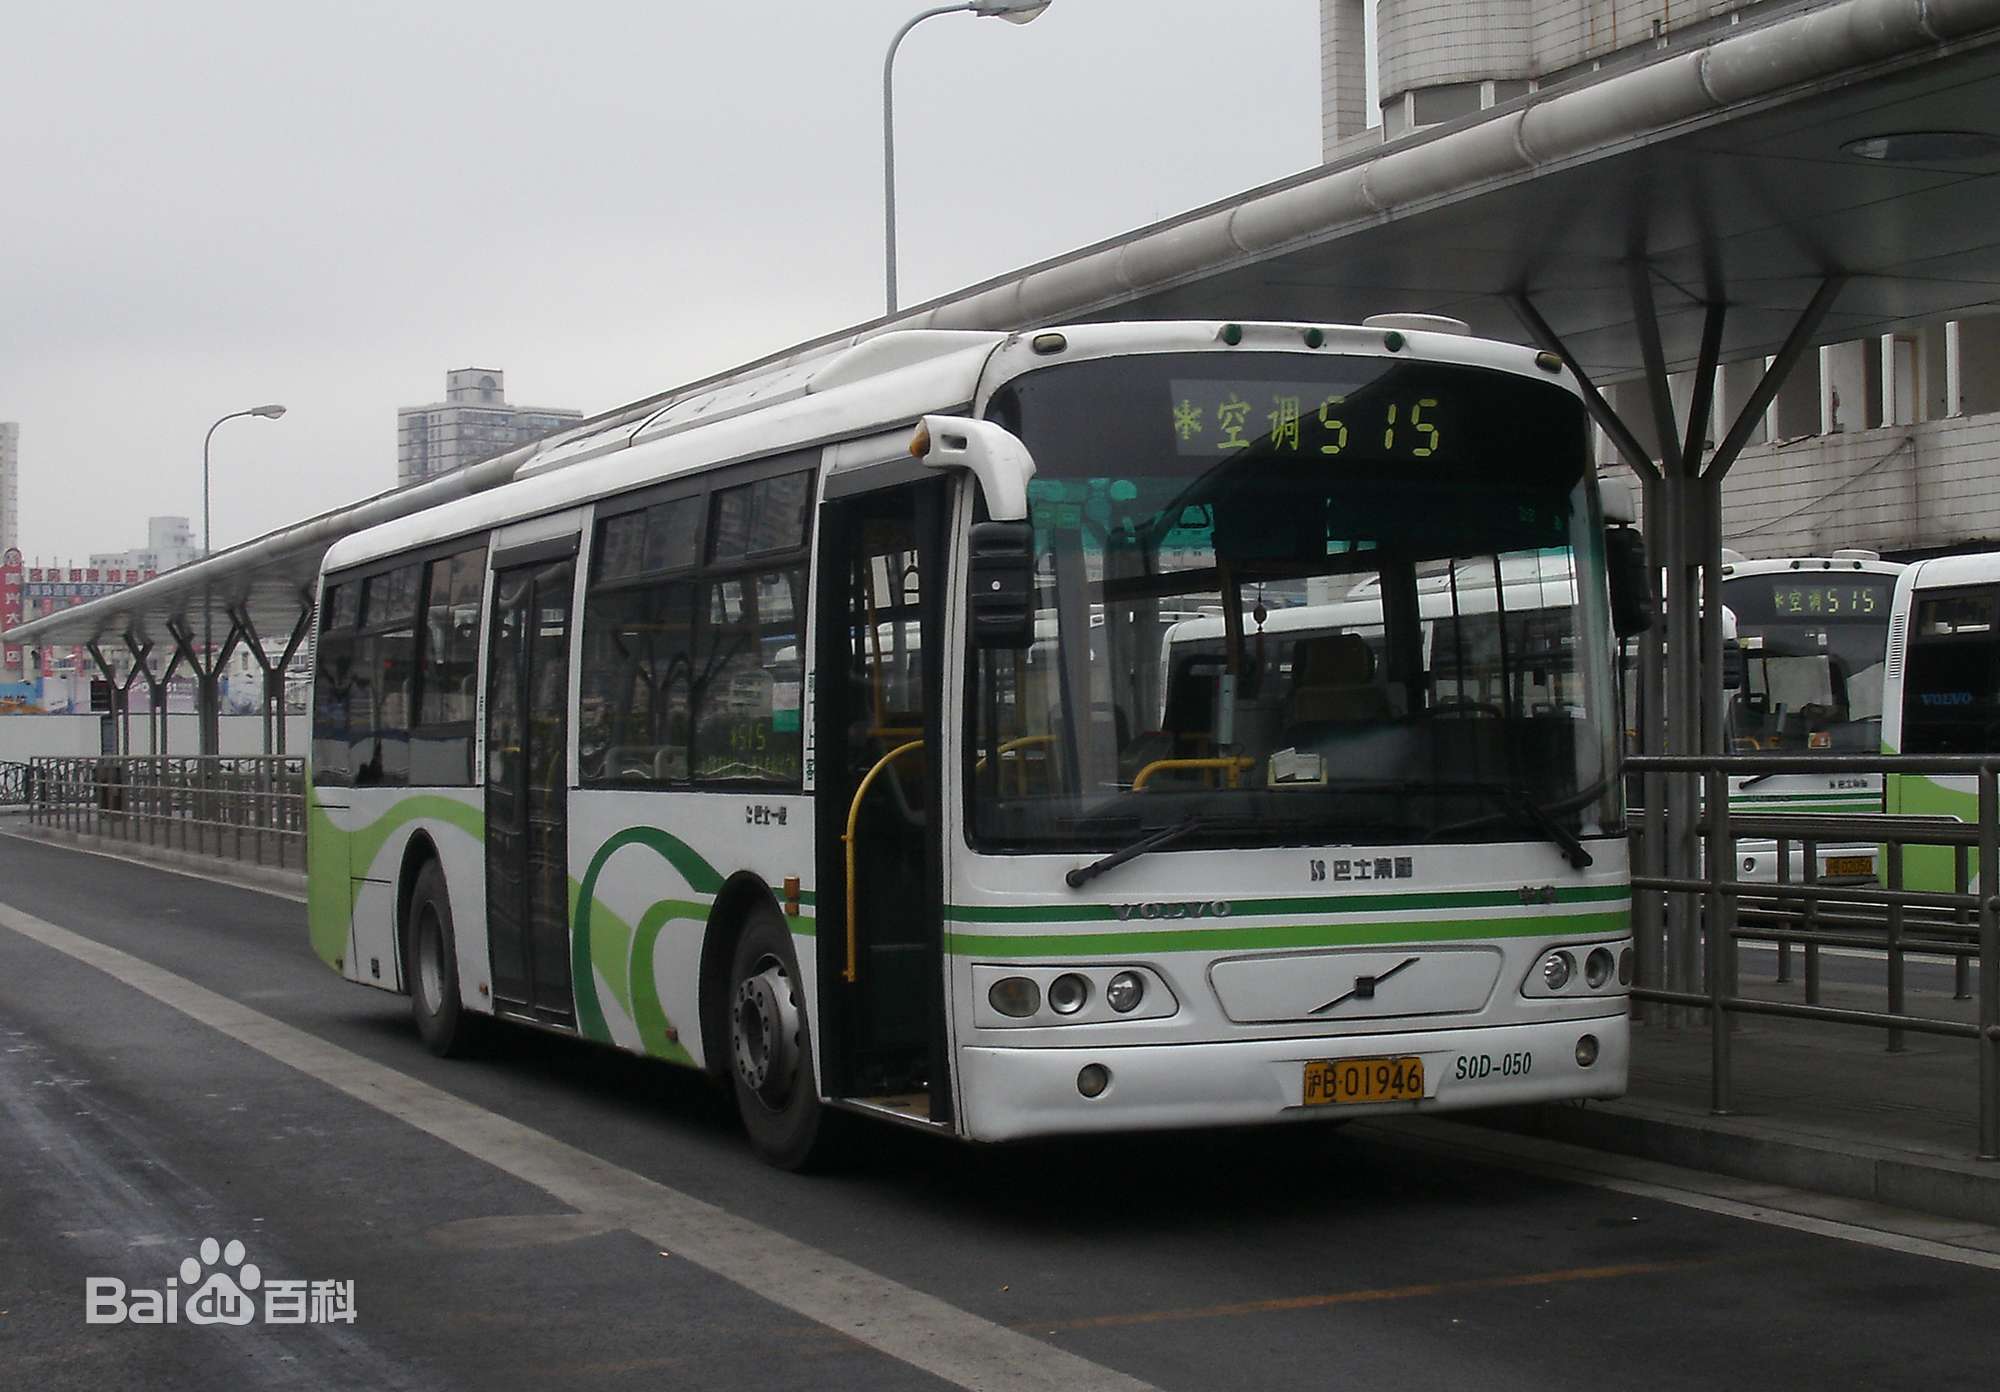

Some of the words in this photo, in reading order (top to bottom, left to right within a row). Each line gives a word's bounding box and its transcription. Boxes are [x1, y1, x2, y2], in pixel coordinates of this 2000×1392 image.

[1217, 392, 1300, 451] 空调
[1319, 395, 1440, 457] 515
[1826, 587, 1875, 613] 515
[1111, 900, 1232, 921] VOLVO
